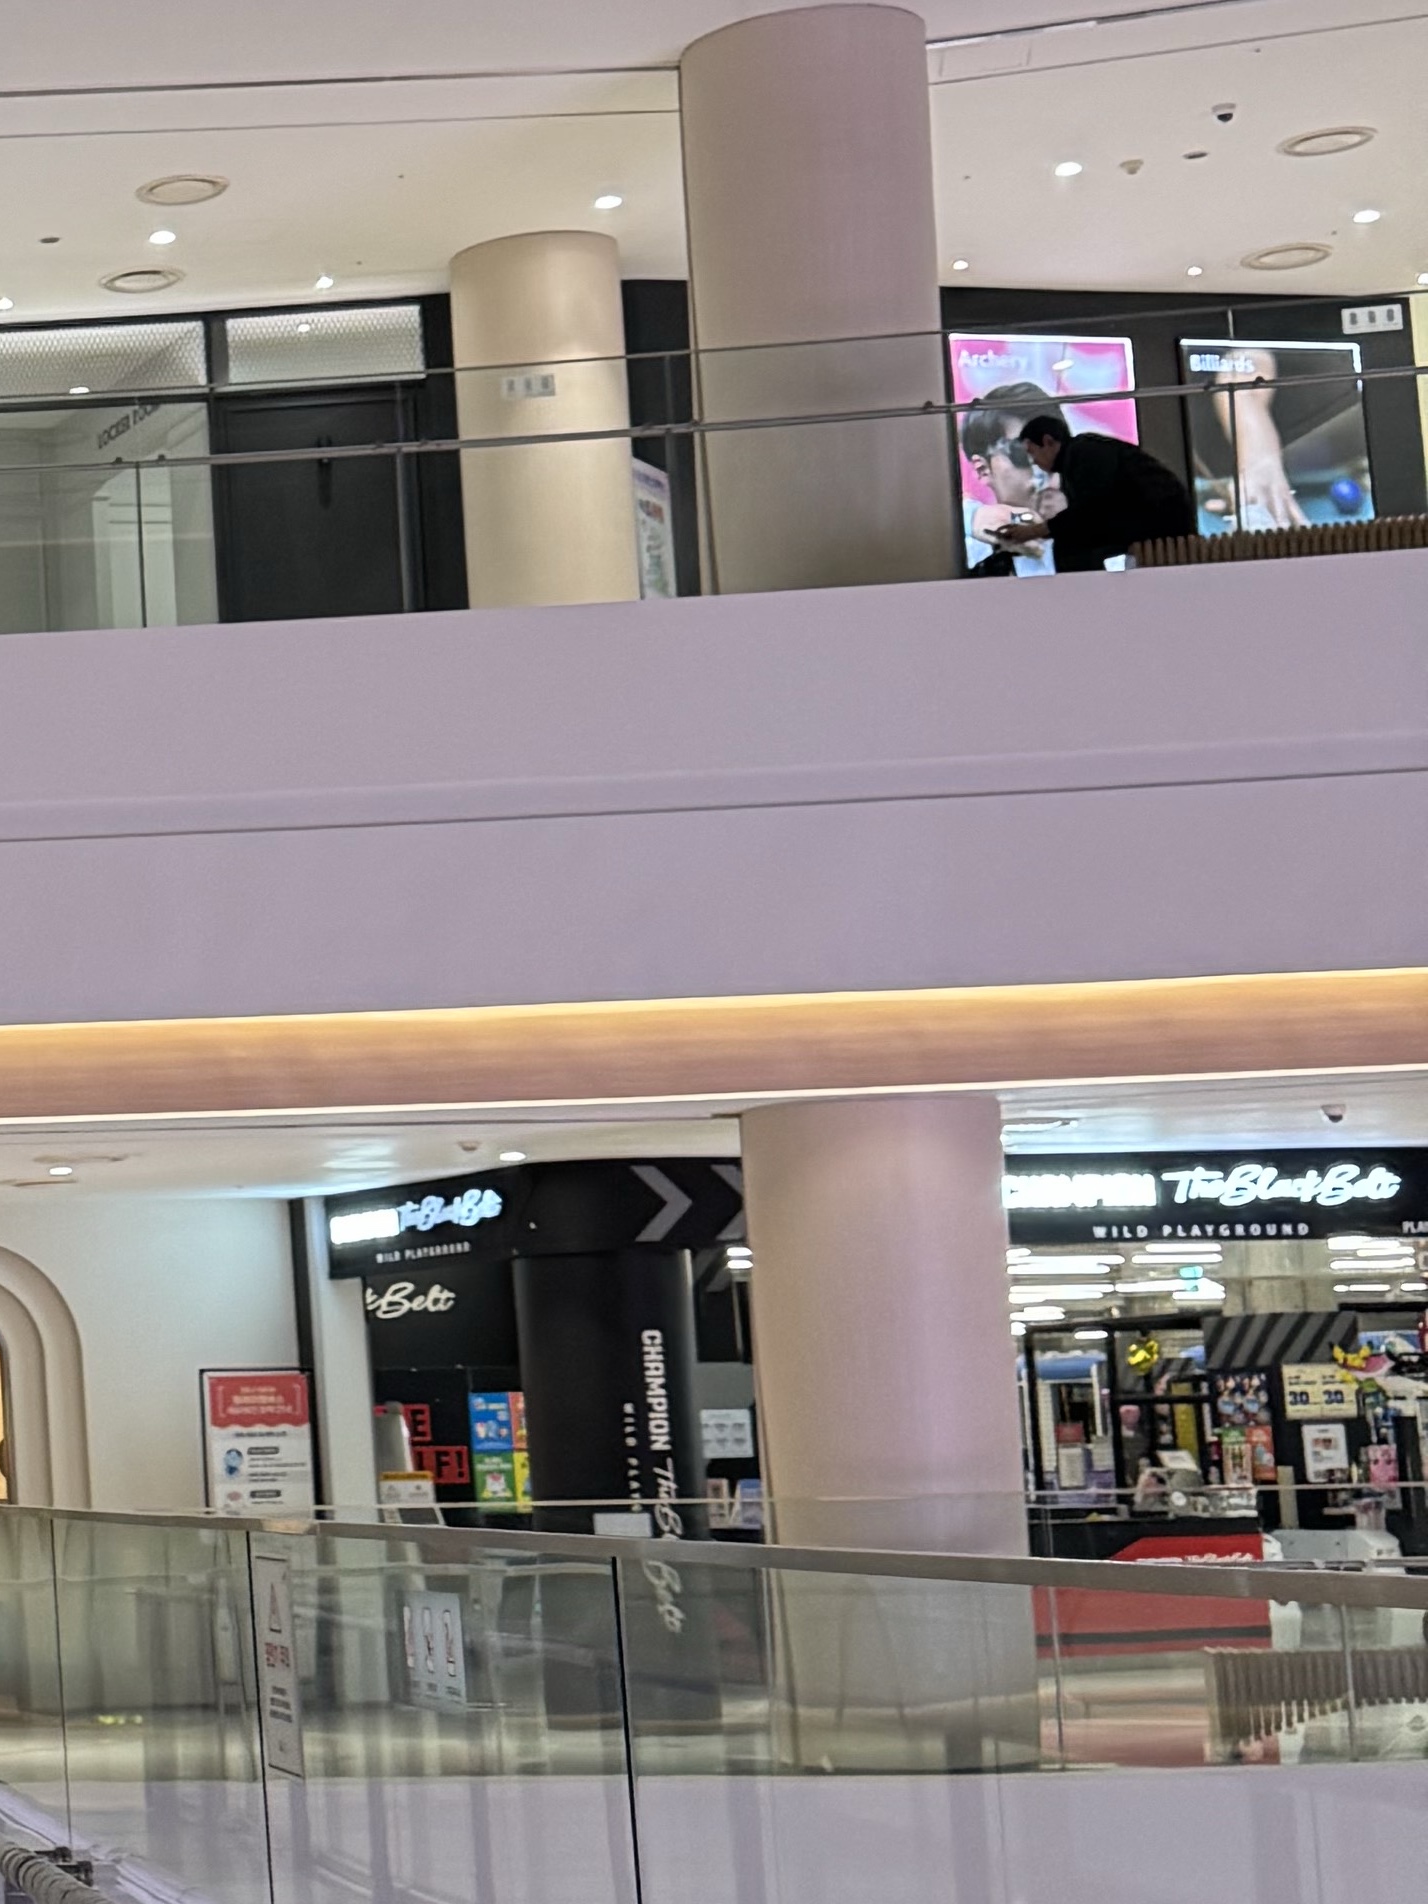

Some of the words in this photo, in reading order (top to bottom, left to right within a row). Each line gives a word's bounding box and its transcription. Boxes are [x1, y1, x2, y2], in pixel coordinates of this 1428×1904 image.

[959, 349, 1029, 372] Archery
[1190, 354, 1254, 373] Billiards
[1093, 1225, 1149, 1238] WILD
[1162, 1222, 1310, 1237] PLAYGROUND
[642, 1329, 672, 1451] CHAMPION
